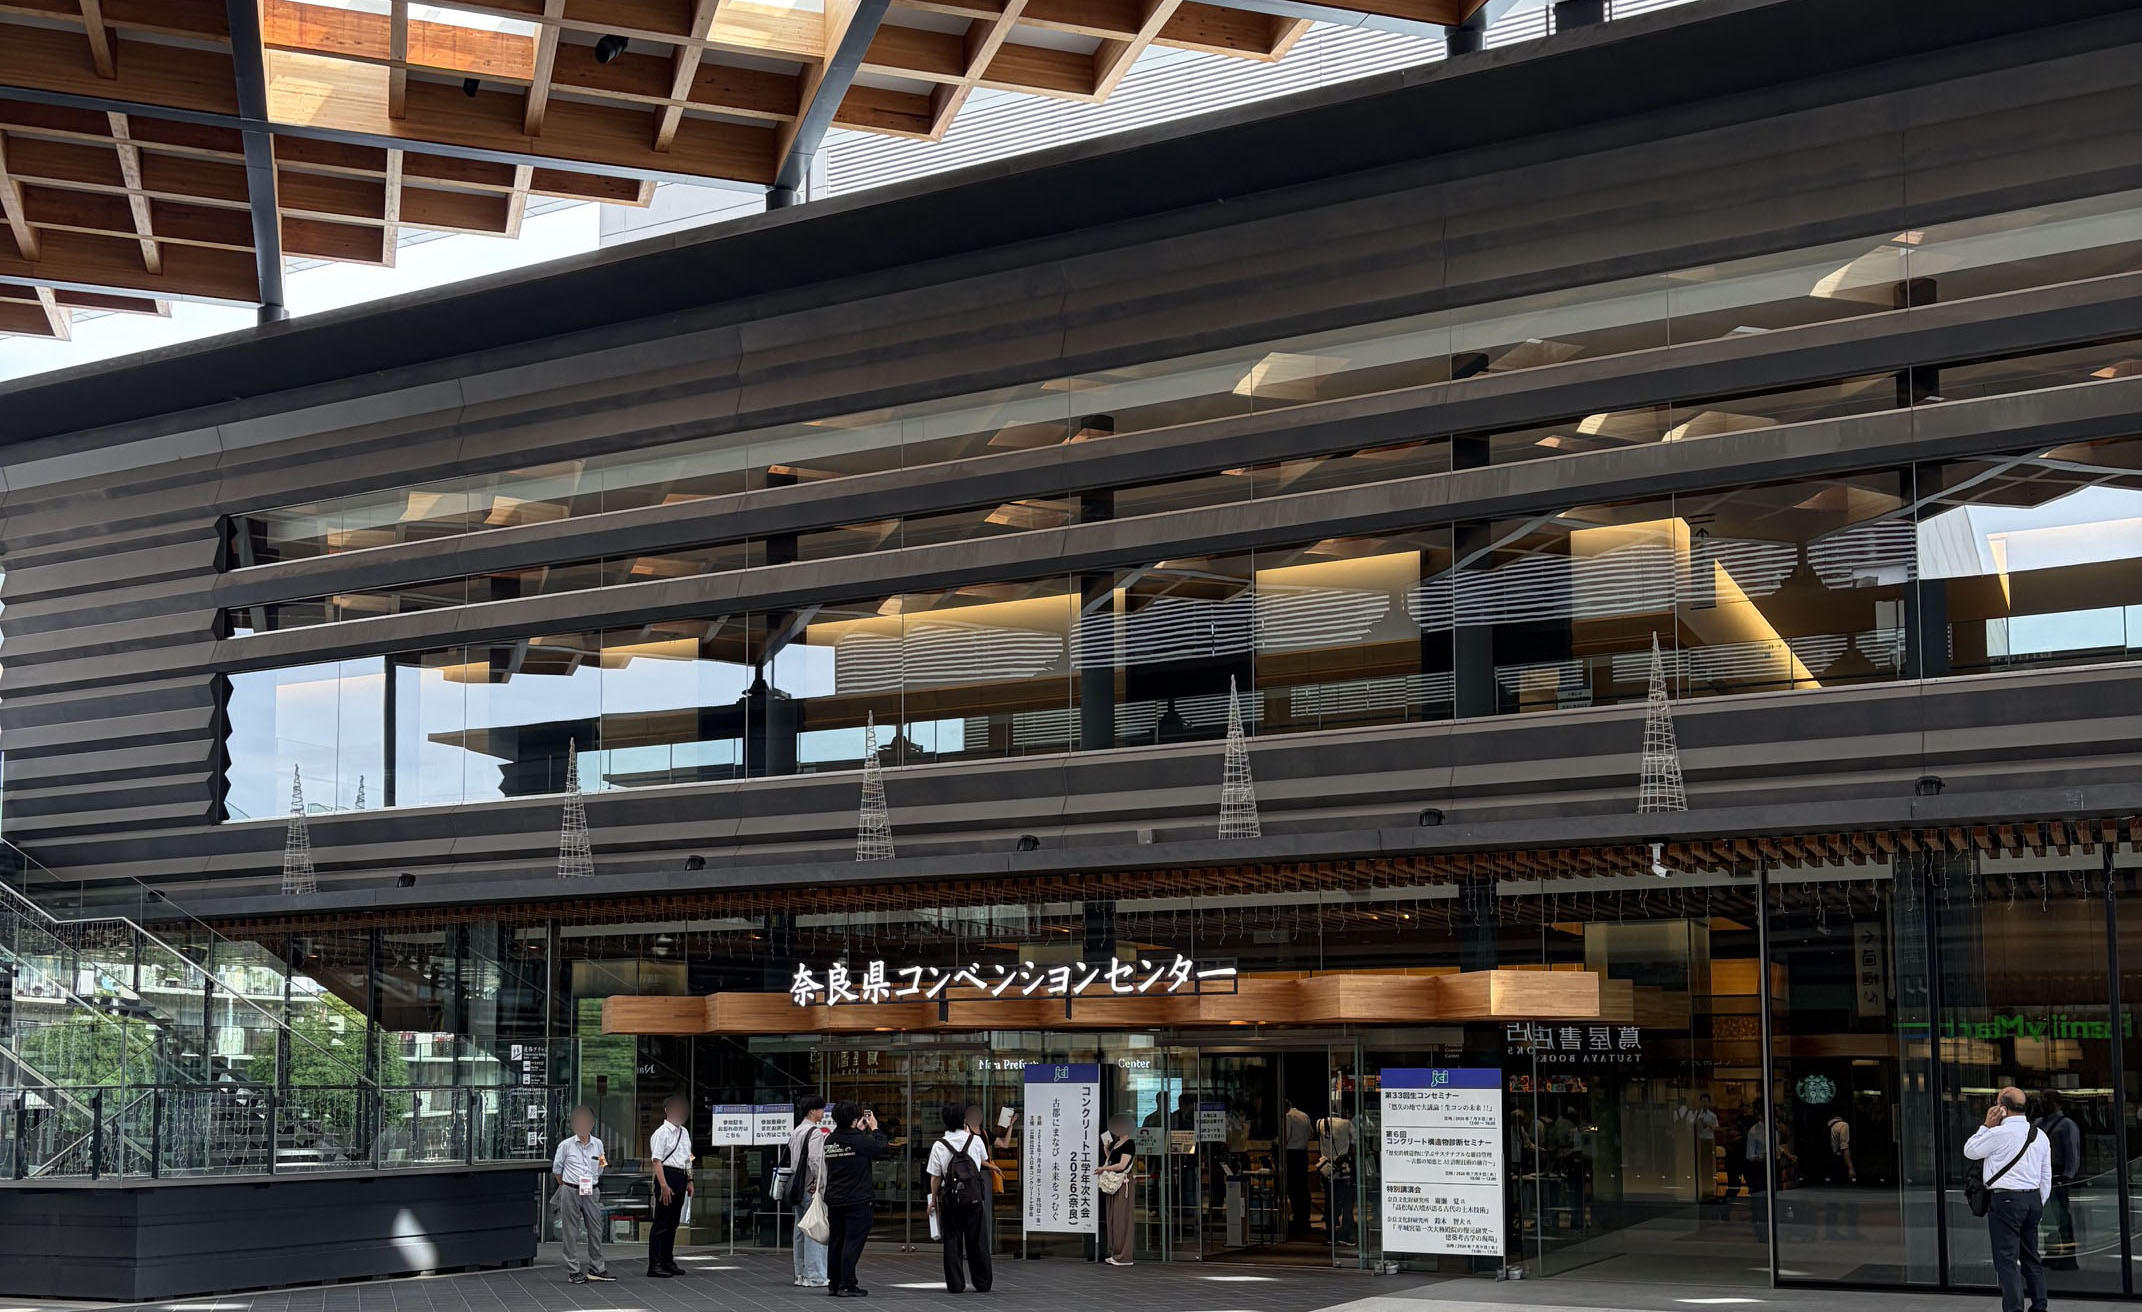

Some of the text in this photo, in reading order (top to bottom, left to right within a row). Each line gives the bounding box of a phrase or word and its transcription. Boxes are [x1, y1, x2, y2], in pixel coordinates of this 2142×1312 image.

[790, 954, 1237, 1007] 奈良県コンベンションセンター
[1118, 1058, 1150, 1069] Center
[1054, 1065, 1069, 1082] jci
[1431, 1069, 1449, 1087] jci
[1385, 1091, 1460, 1100] 第33回生コンセミナー
[1385, 1130, 1407, 1138] 第6回
[1386, 1138, 1492, 1146] コンクリート構造物診断セミナー
[1080, 1086, 1091, 1219] コンクリート工学年次大会
[1051, 1098, 1061, 1221] 古都にまなび 未来をつむぐ
[1386, 1185, 1422, 1193] 特別講演会
[1387, 1196, 1430, 1204] 奈良文化財研究所
[1387, 1216, 1429, 1224] 奈良文化財研究所
